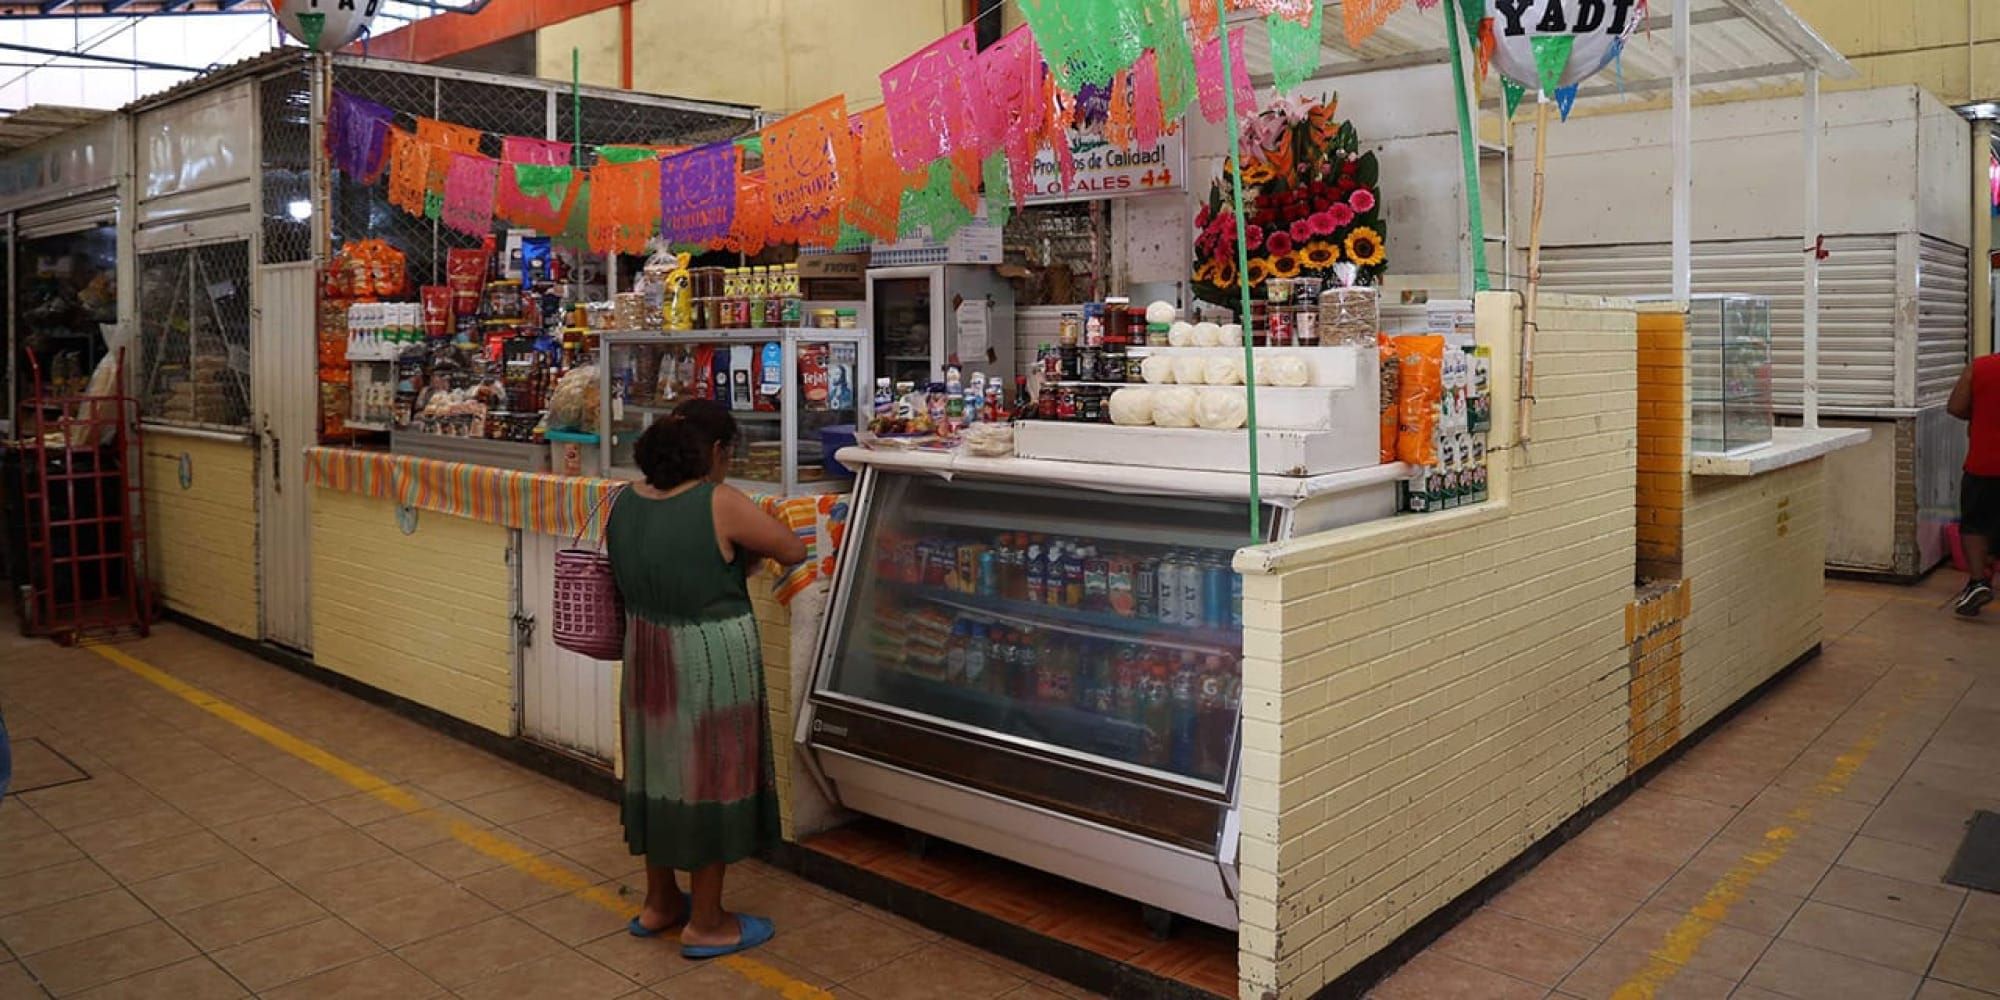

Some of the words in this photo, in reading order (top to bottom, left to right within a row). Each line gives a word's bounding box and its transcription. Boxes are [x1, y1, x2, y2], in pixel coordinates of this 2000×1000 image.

[311, 0, 378, 17] AD
[1495, 0, 1634, 36] YADI
[1033, 156, 1085, 175] Proos
[1088, 152, 1102, 169] de
[1106, 144, 1165, 167] Calidad!
[1140, 168, 1173, 187] 44
